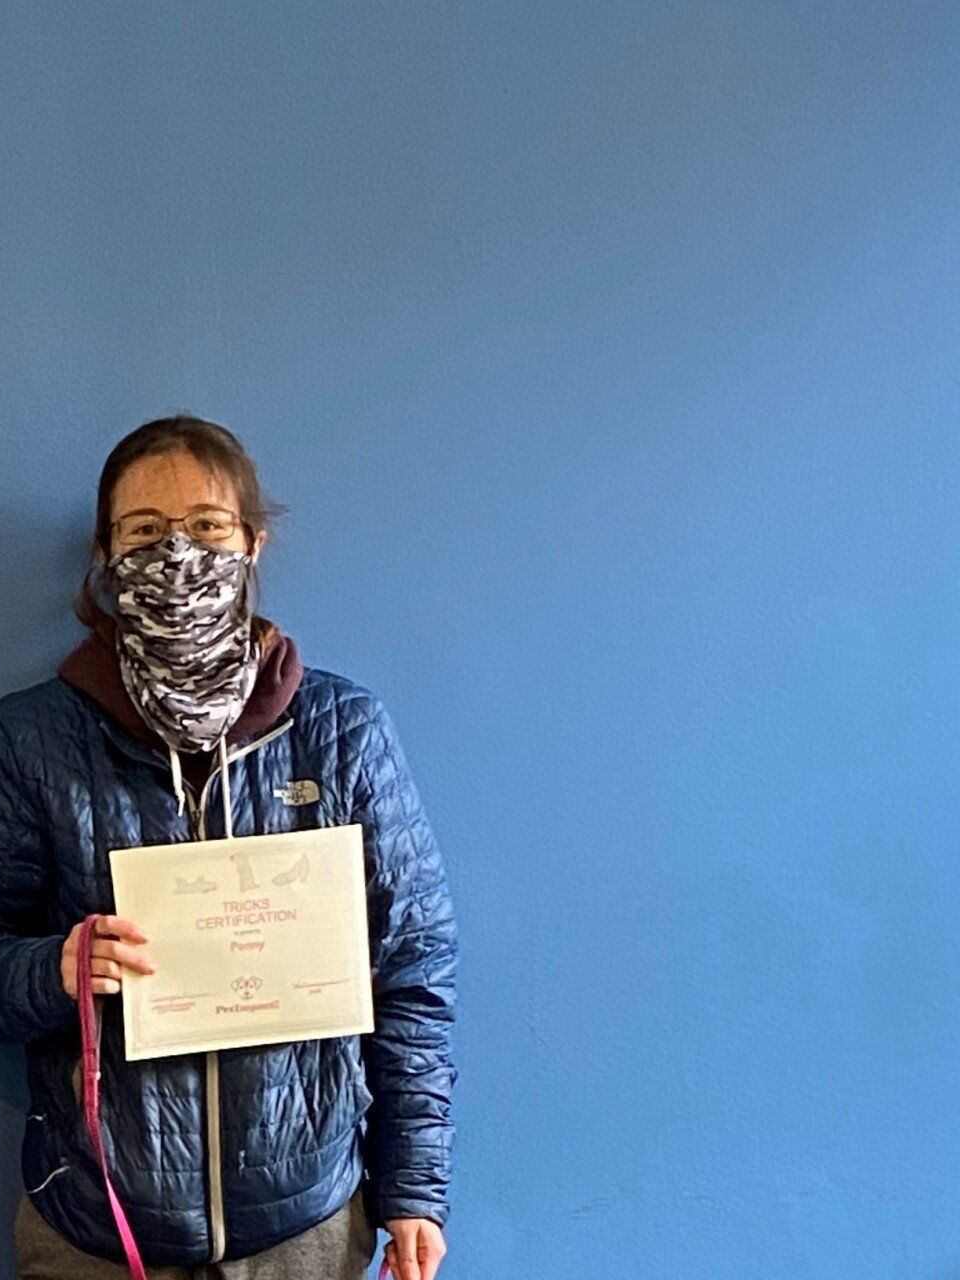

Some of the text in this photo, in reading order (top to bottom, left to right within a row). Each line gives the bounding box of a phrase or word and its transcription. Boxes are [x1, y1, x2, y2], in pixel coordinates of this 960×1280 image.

[223, 898, 270, 912] TRICKS
[196, 909, 297, 930] CERTIFICATION
[230, 941, 265, 952] Penny
